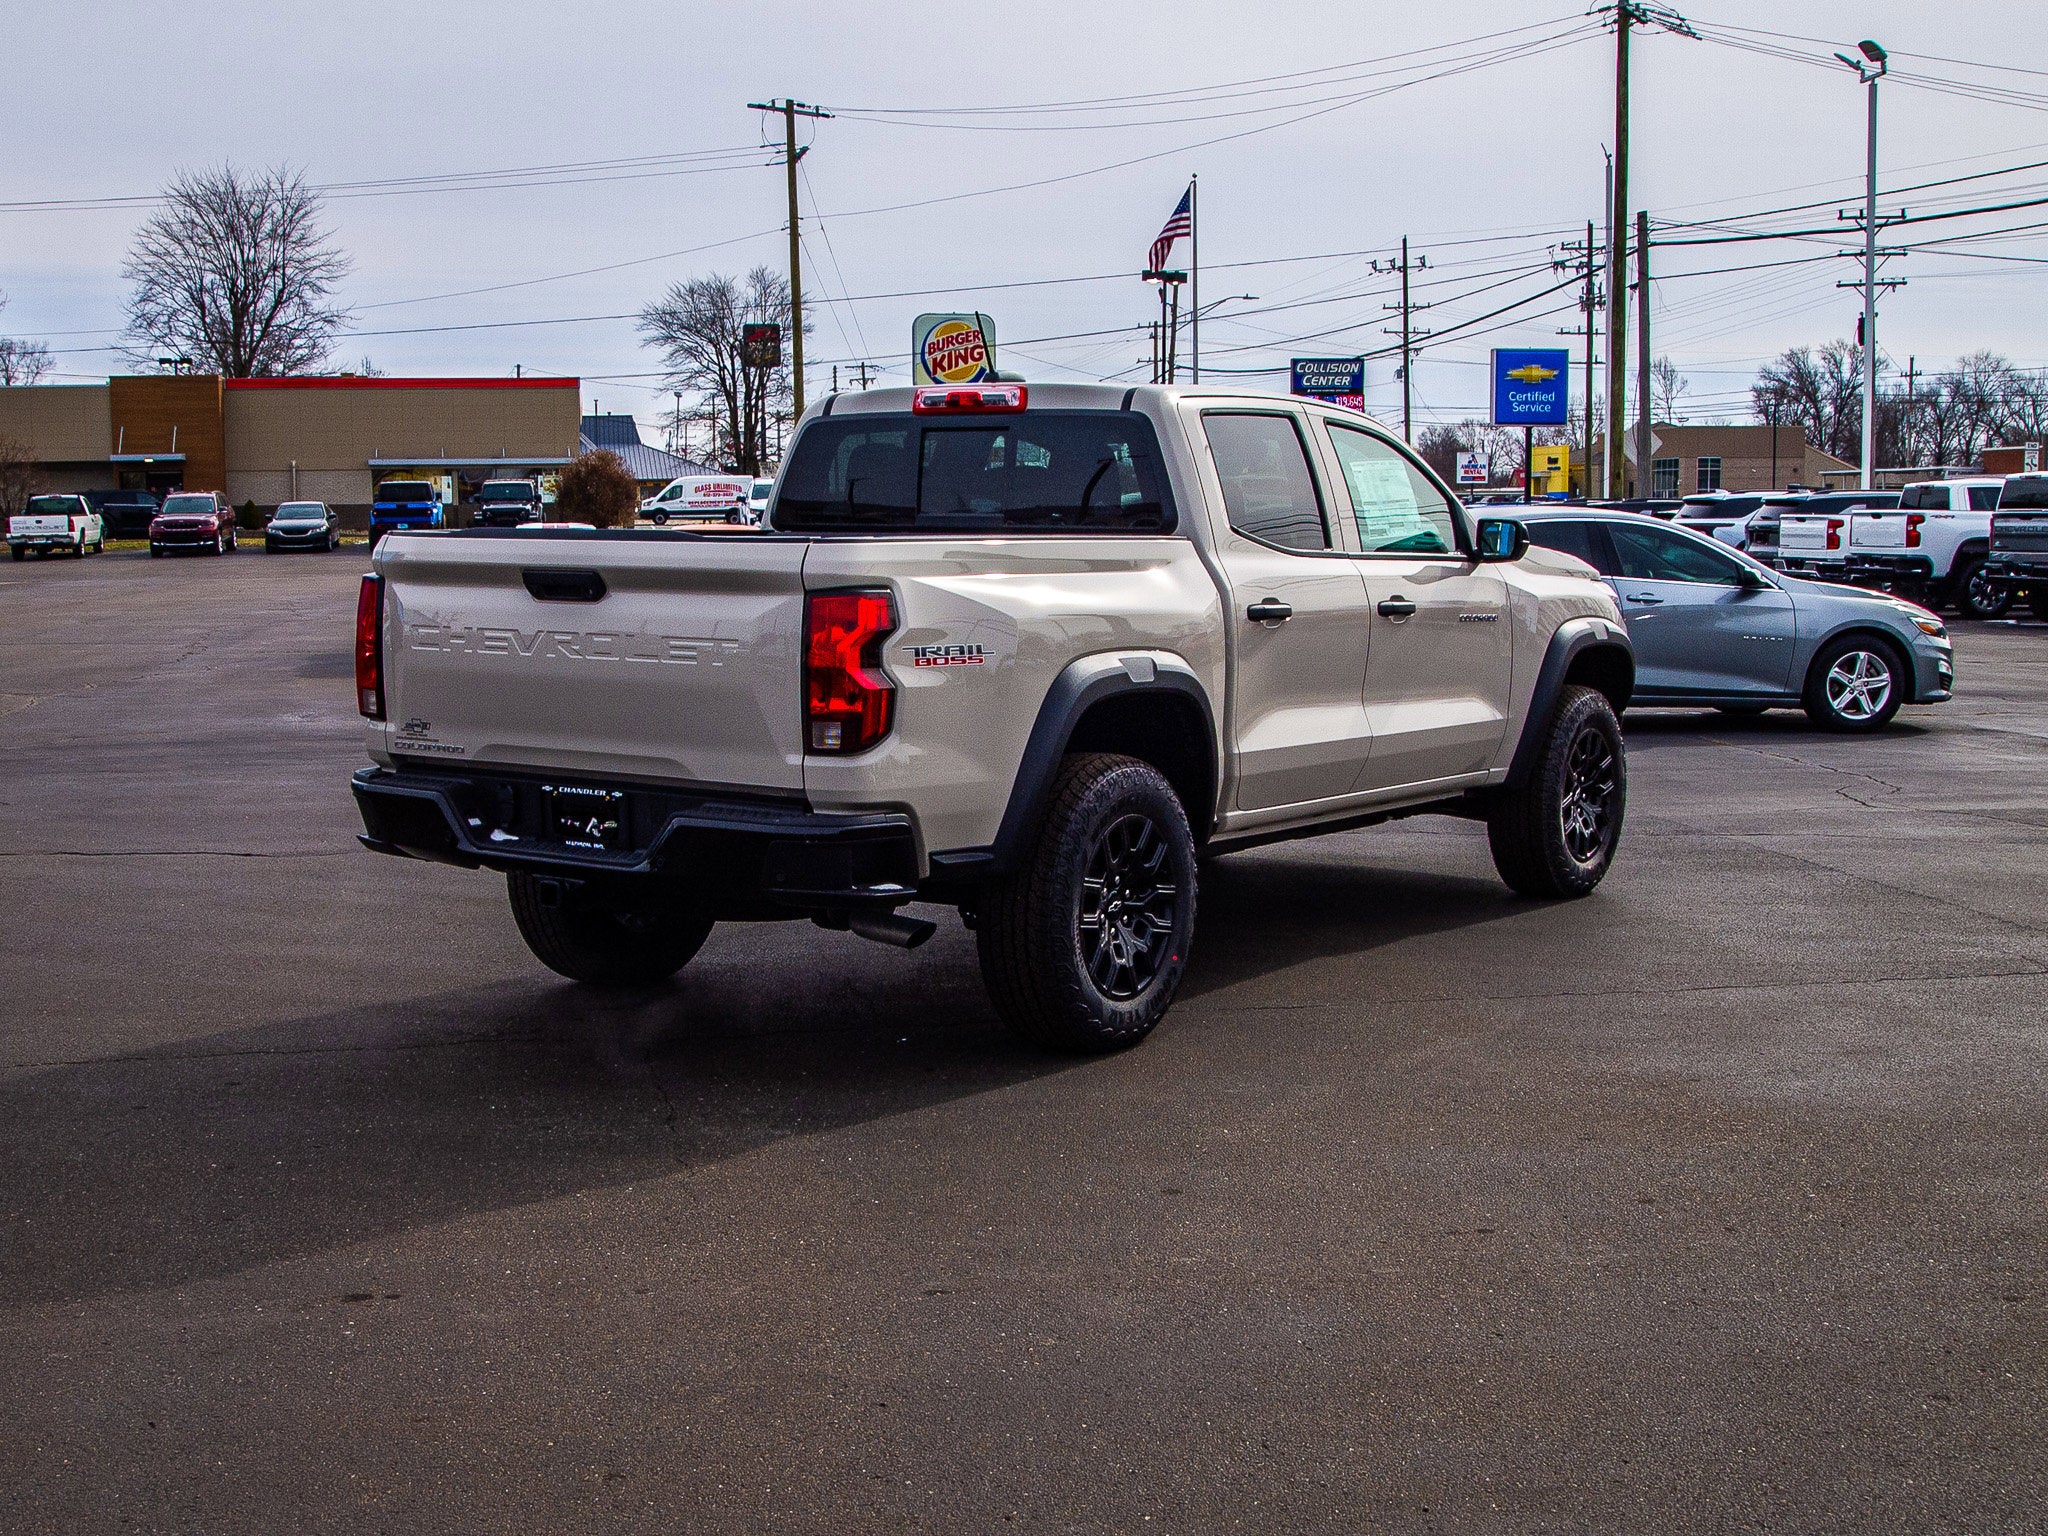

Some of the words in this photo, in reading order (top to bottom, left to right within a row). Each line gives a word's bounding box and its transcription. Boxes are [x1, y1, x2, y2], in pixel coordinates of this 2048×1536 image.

[928, 330, 981, 356] BURGER
[932, 345, 984, 376] KING
[1297, 362, 1359, 373] COLLISION
[1303, 375, 1350, 386] CENTER
[1509, 392, 1555, 401] Certified
[1512, 402, 1551, 412] Service
[411, 624, 739, 666] CHEVROLET
[902, 644, 995, 657] TRAIL
[914, 656, 984, 667] BOSS
[559, 786, 606, 796] CHANDLER
